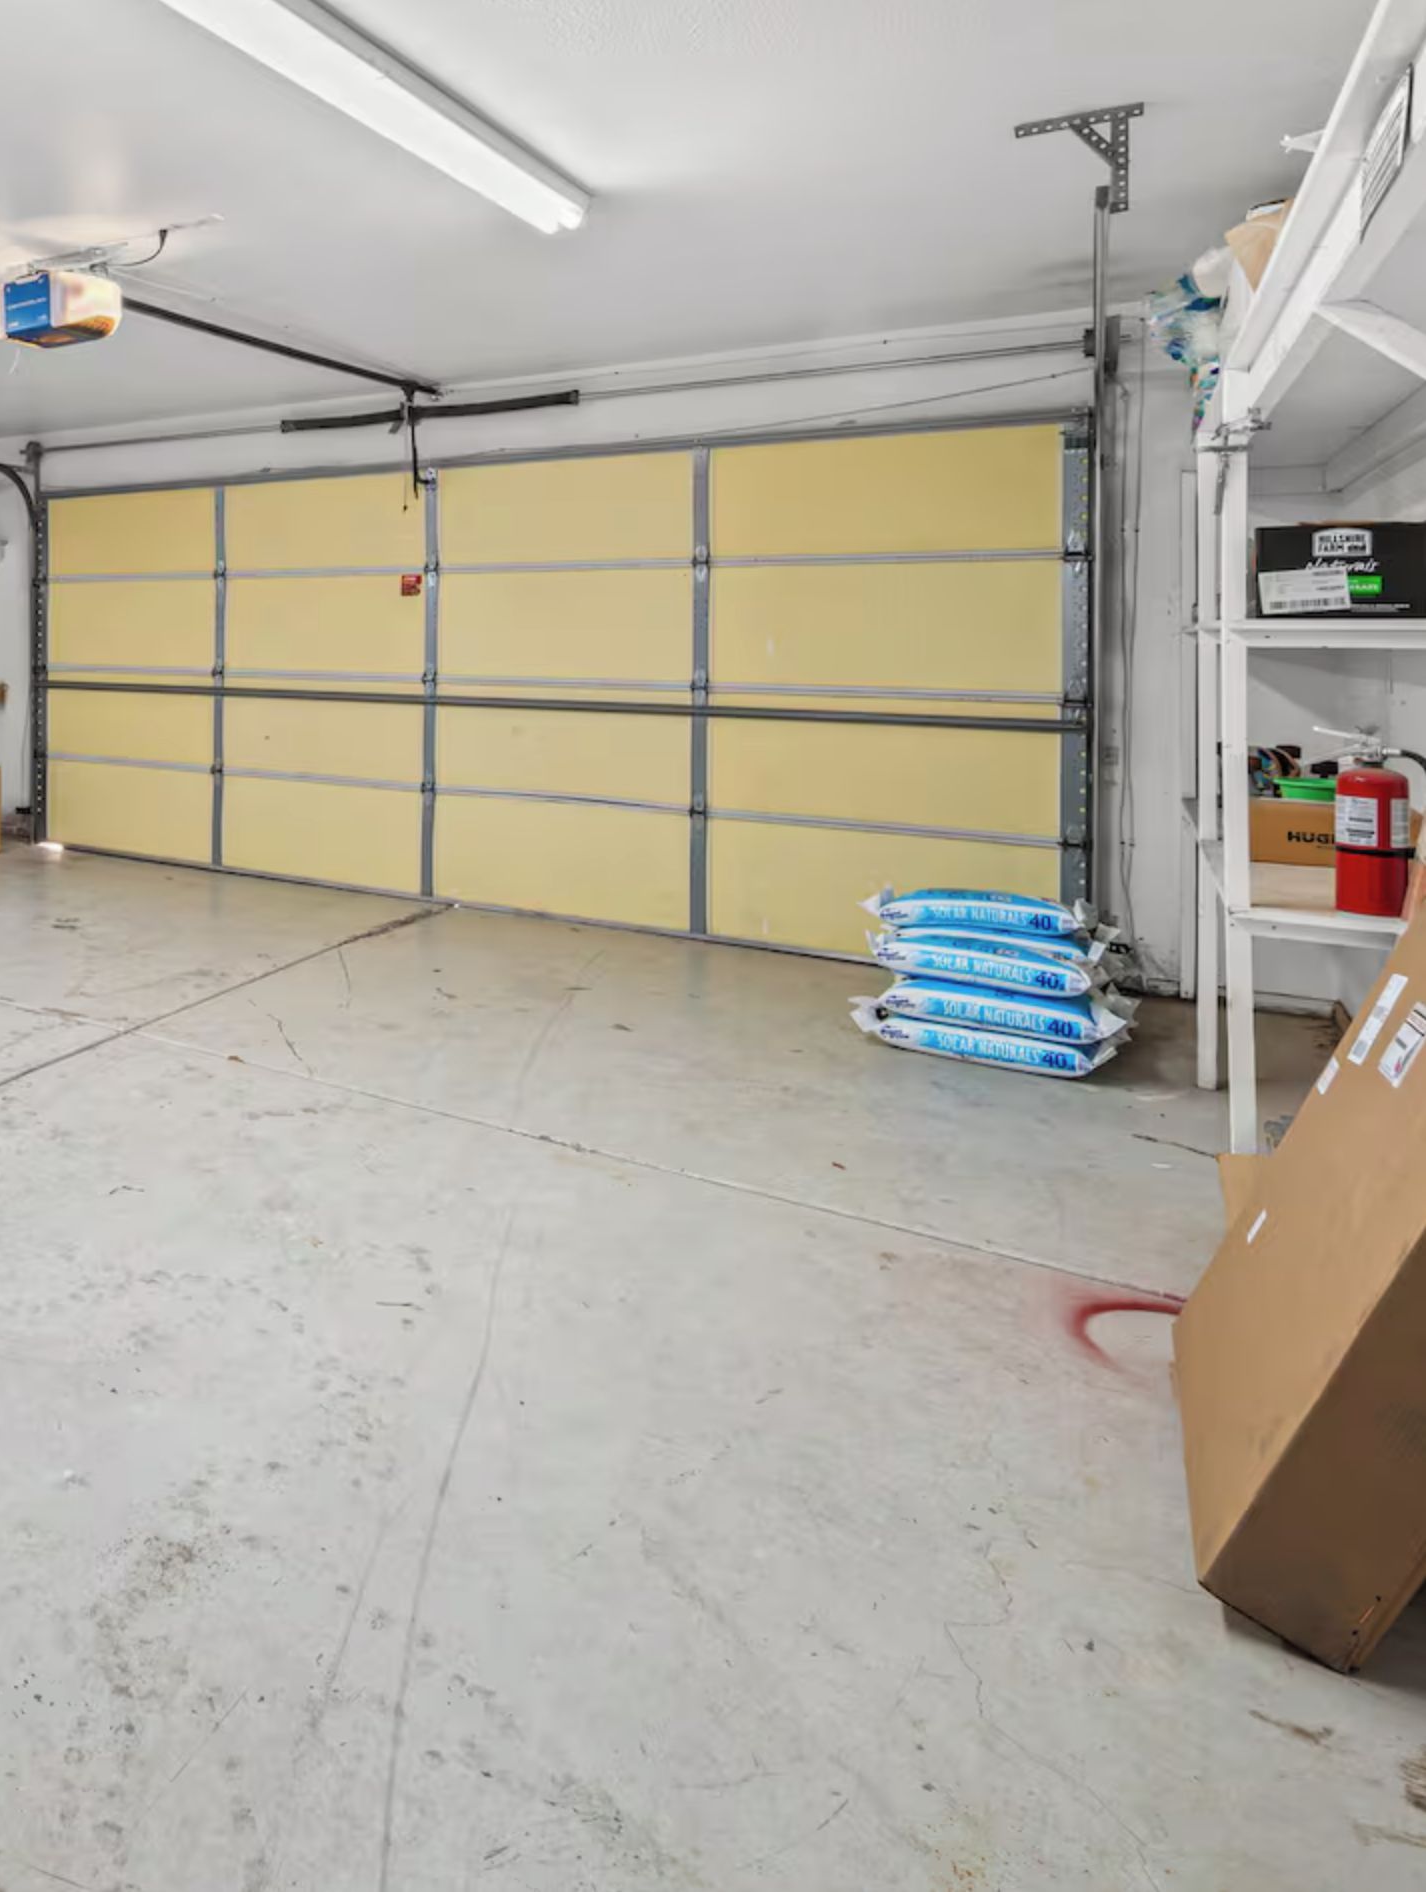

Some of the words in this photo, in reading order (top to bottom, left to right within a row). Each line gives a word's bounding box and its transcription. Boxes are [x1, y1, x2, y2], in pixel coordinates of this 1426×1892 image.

[1317, 543, 1345, 554] FARM
[1287, 831, 1335, 845] HUG
[933, 905, 968, 922] SOLAR
[973, 907, 1026, 926] NATURALS
[1029, 914, 1052, 931] 40
[932, 954, 970, 971] SOLAR
[973, 959, 1033, 983] NATURALS
[1034, 972, 1059, 990] 40
[943, 1000, 981, 1019] SOLAR
[983, 1006, 1046, 1032] NATURALS
[1047, 1020, 1073, 1038] 40
[937, 1032, 973, 1050] SOLAR
[978, 1039, 1040, 1062] NATURALS
[1041, 1052, 1067, 1069] 40
